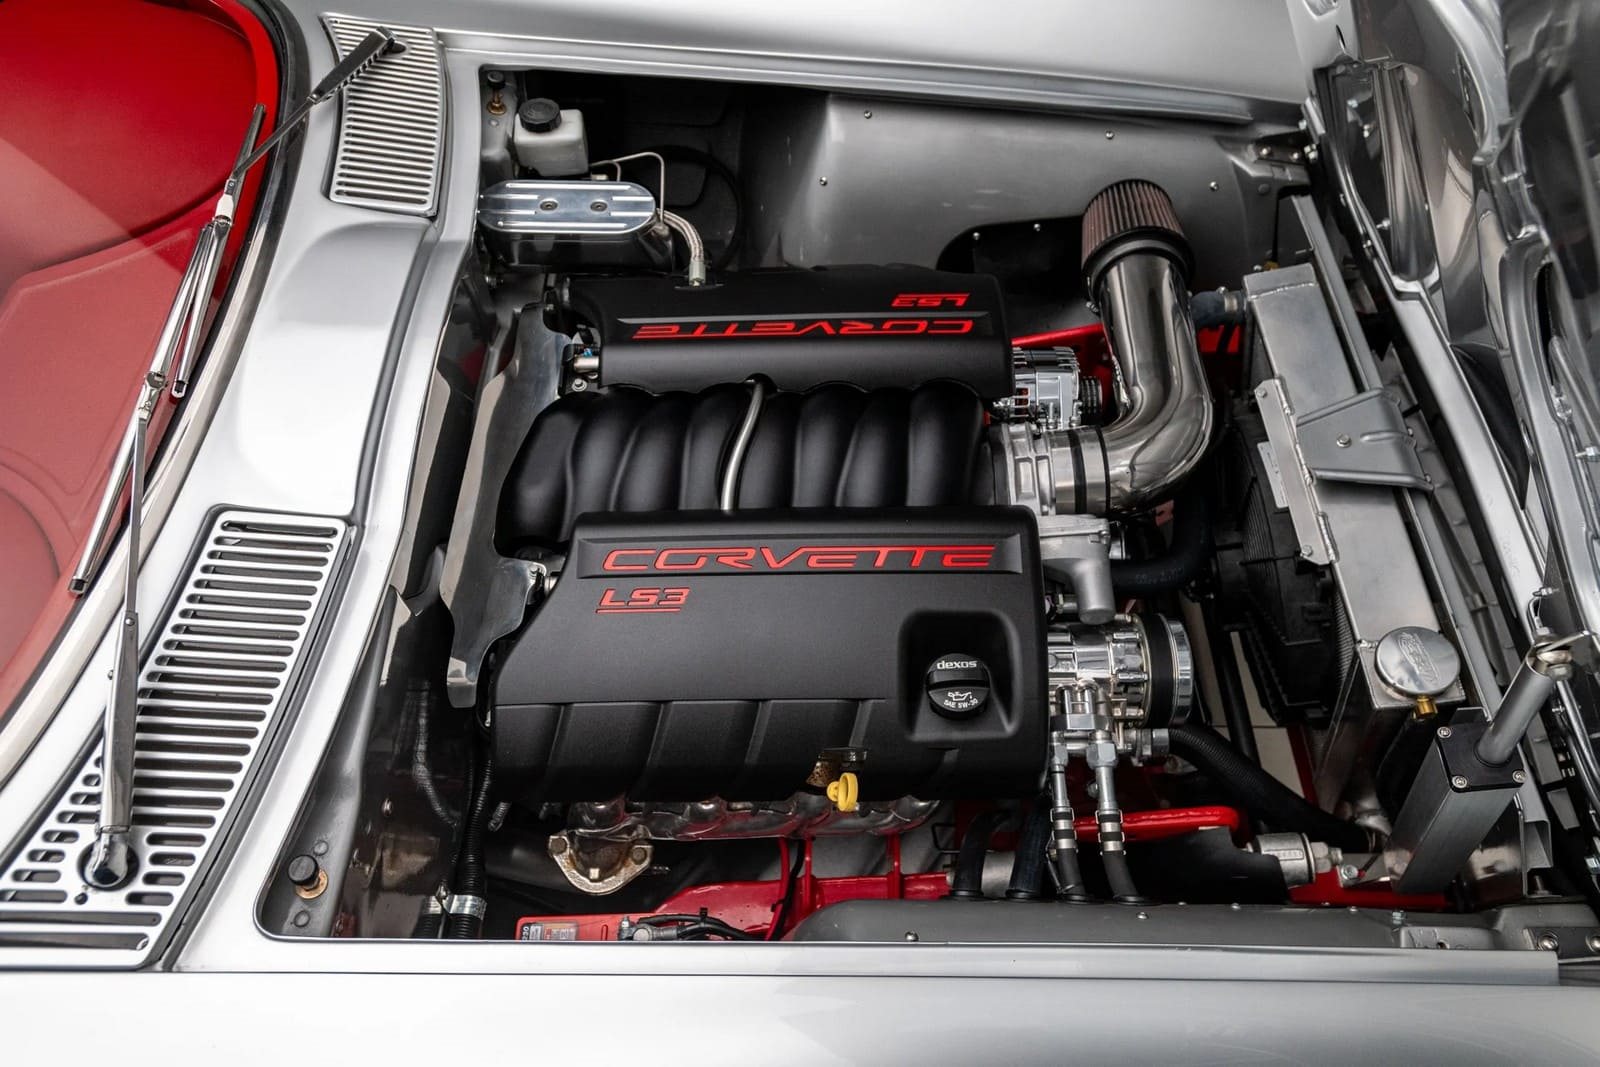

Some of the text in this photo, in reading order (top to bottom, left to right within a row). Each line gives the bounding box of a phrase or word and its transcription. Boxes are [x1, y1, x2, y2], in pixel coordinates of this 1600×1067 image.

[891, 293, 970, 308] LS3
[633, 319, 974, 340] CORVETTE
[602, 544, 996, 571] CORVETTE
[598, 587, 690, 608] LS3
[936, 660, 978, 670] dexos
